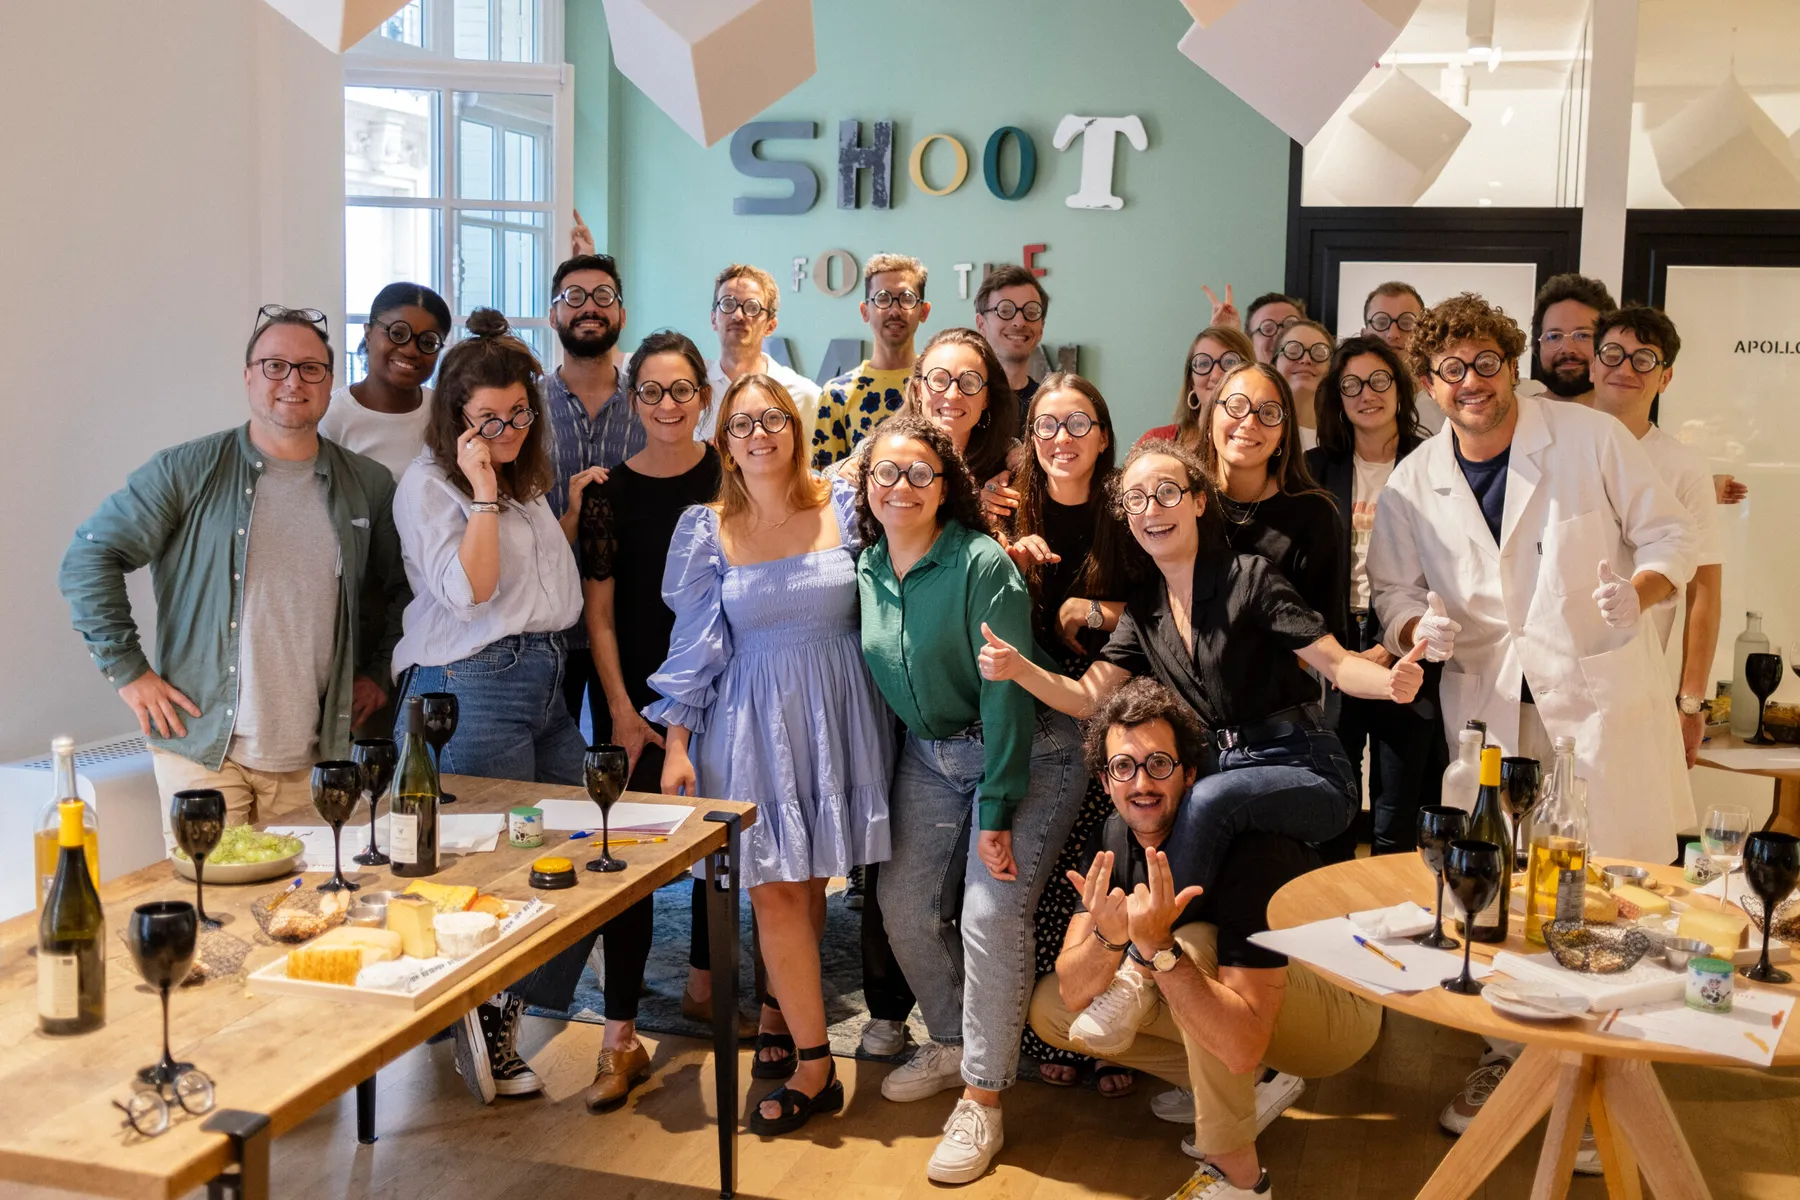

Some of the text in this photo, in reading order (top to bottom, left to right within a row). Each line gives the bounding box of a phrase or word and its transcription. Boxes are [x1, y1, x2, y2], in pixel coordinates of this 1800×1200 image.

[730, 114, 1148, 214] SHOOT
[791, 243, 1047, 299] FO TE
